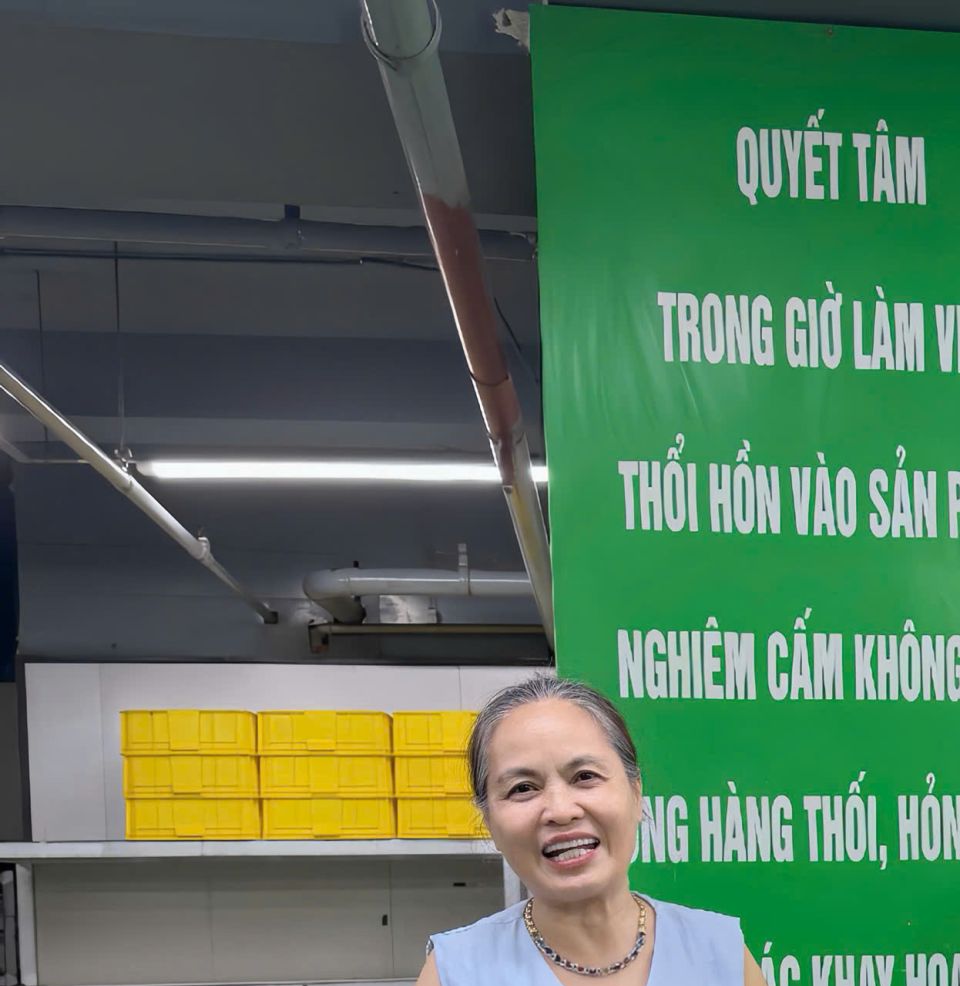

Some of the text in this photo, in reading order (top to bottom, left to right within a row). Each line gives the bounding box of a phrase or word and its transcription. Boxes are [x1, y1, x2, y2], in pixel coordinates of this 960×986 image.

[736, 108, 926, 205] QUYẾT TÂM
[656, 290, 775, 367] TRONG
[786, 280, 843, 369] GIỜ
[852, 285, 925, 372] LÀM
[617, 432, 699, 532] THỔI
[708, 439, 781, 535] HỒN
[790, 451, 857, 537] VÀO
[868, 445, 938, 538] SẢN
[617, 616, 757, 700] NGHIÊM
[767, 607, 844, 700] CẤM
[699, 781, 794, 863] HÀNG
[803, 770, 887, 869] THỐI,
